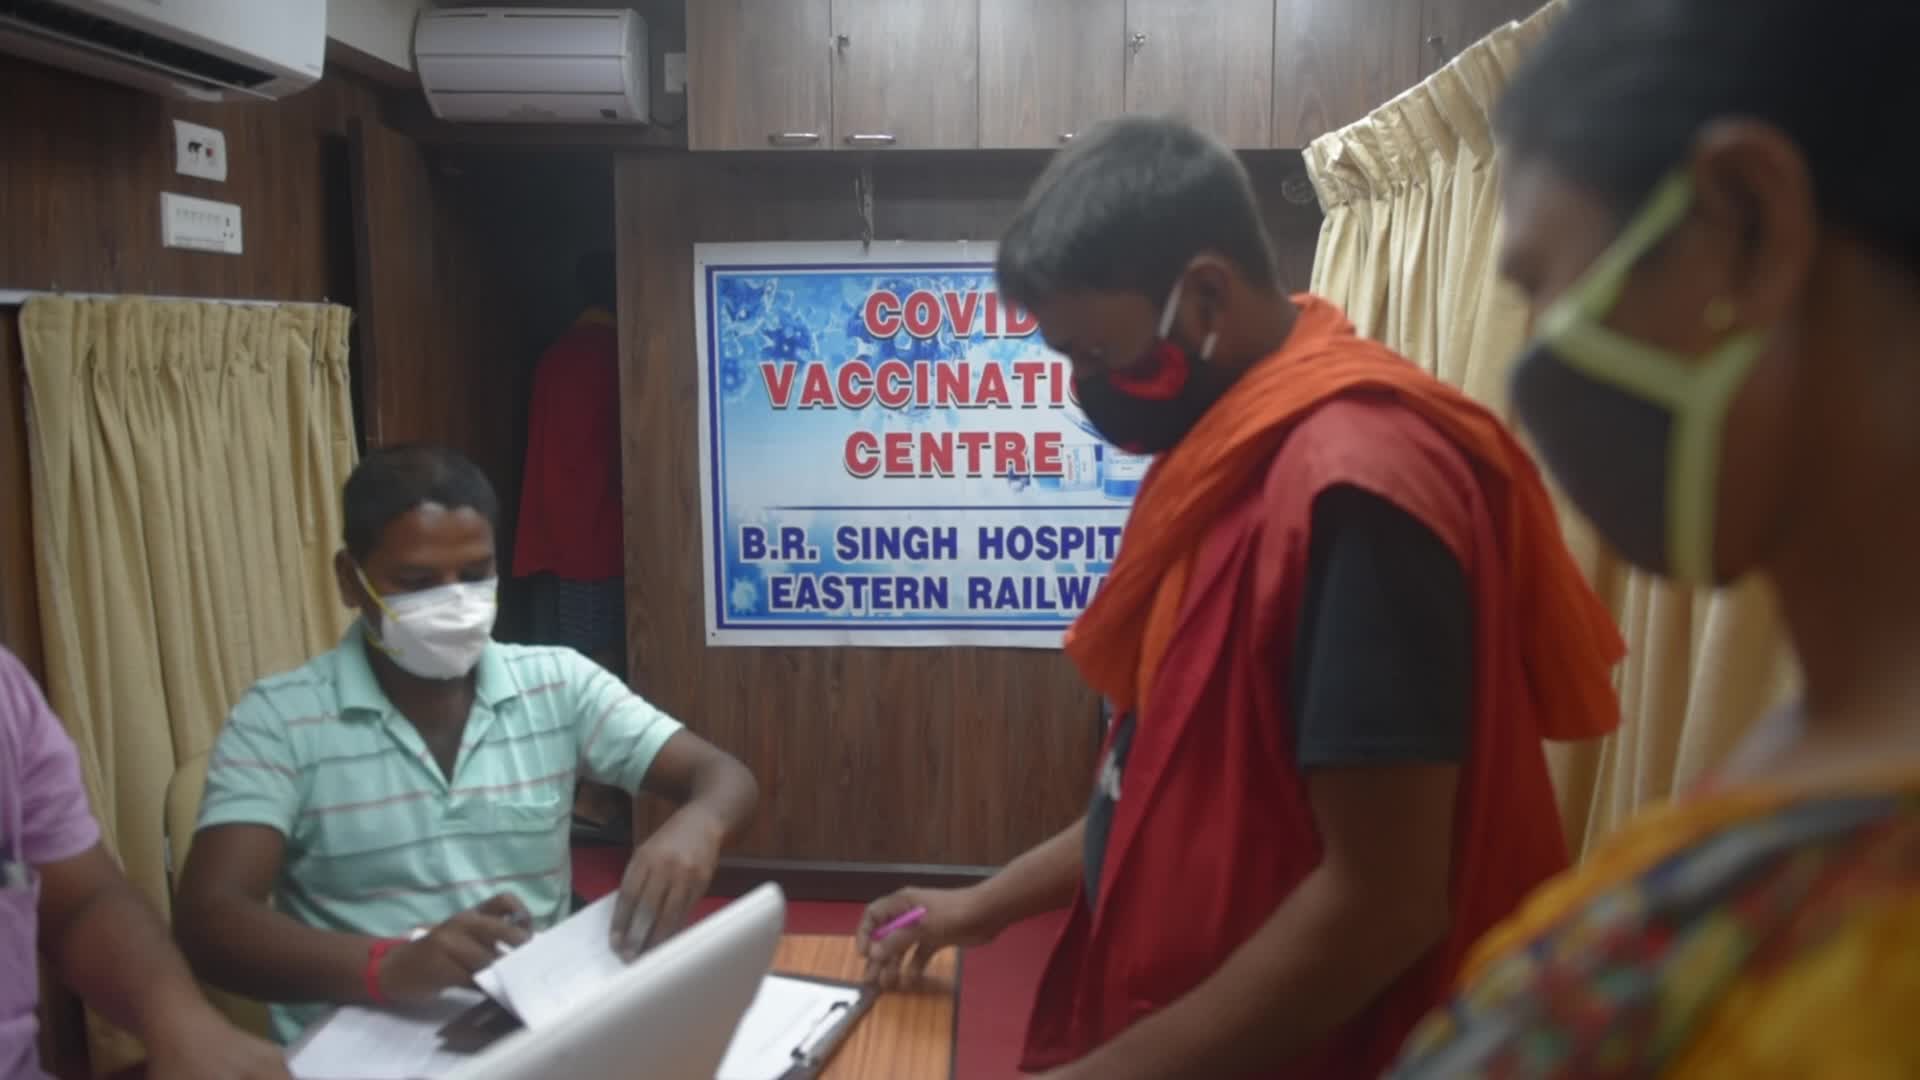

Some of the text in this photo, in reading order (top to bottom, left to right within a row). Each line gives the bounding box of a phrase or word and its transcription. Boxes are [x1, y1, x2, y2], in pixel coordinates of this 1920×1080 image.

[864, 289, 1039, 338] COVID
[761, 361, 1081, 408] VACCINATI
[844, 431, 1065, 477] CENTRE
[742, 526, 1123, 561] B.R. SINGH HOSPIT
[770, 575, 1106, 610] EASTERN RAILW
